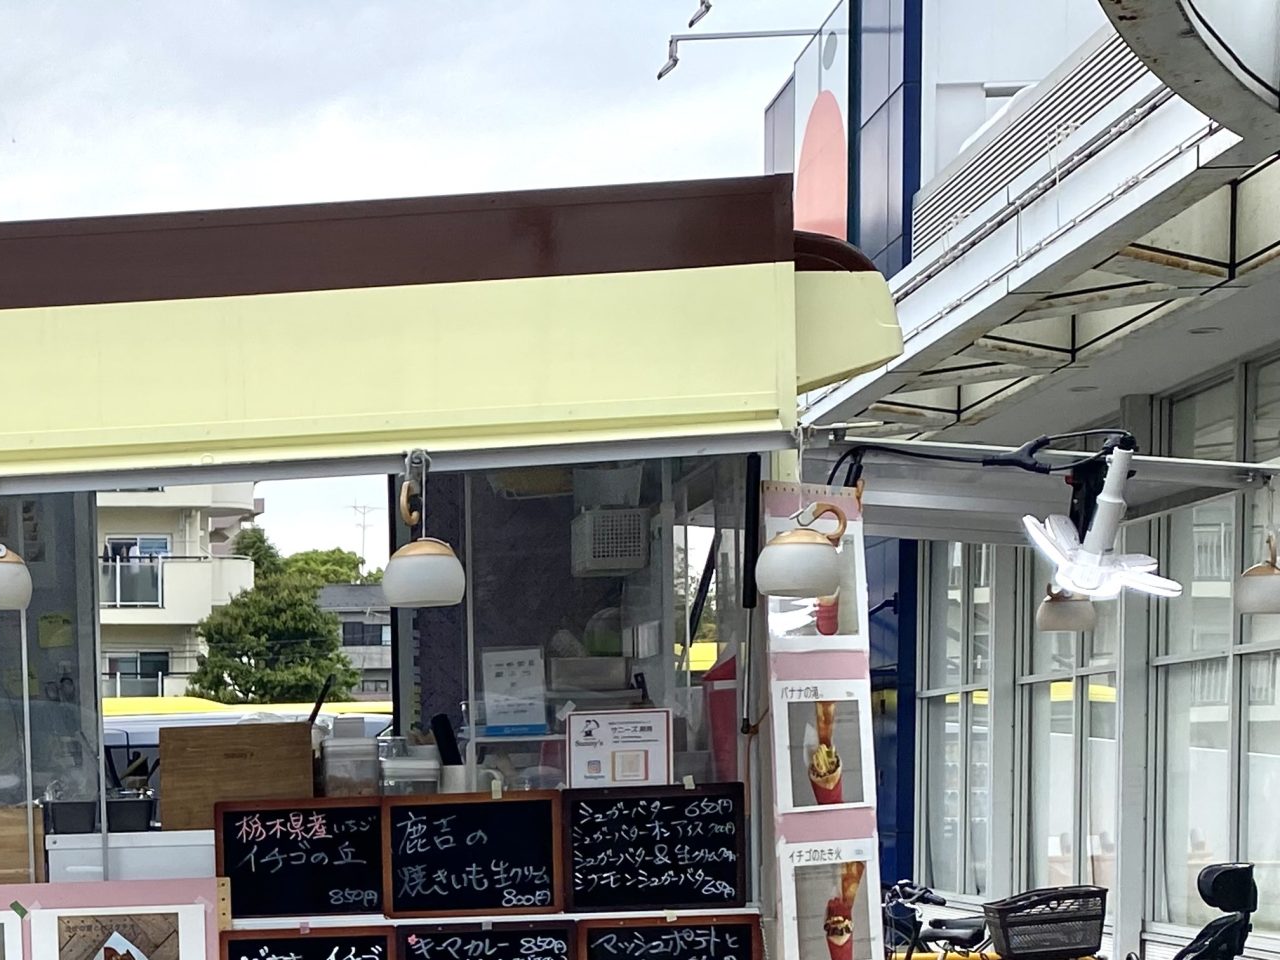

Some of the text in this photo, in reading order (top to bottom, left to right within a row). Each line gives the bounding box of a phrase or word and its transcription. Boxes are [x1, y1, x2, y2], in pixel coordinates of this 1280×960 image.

[234, 841, 368, 874] イチゴの丘
[328, 888, 378, 907] 850円
[501, 888, 551, 907] 800円
[411, 935, 568, 960] キーマカレー 850円
